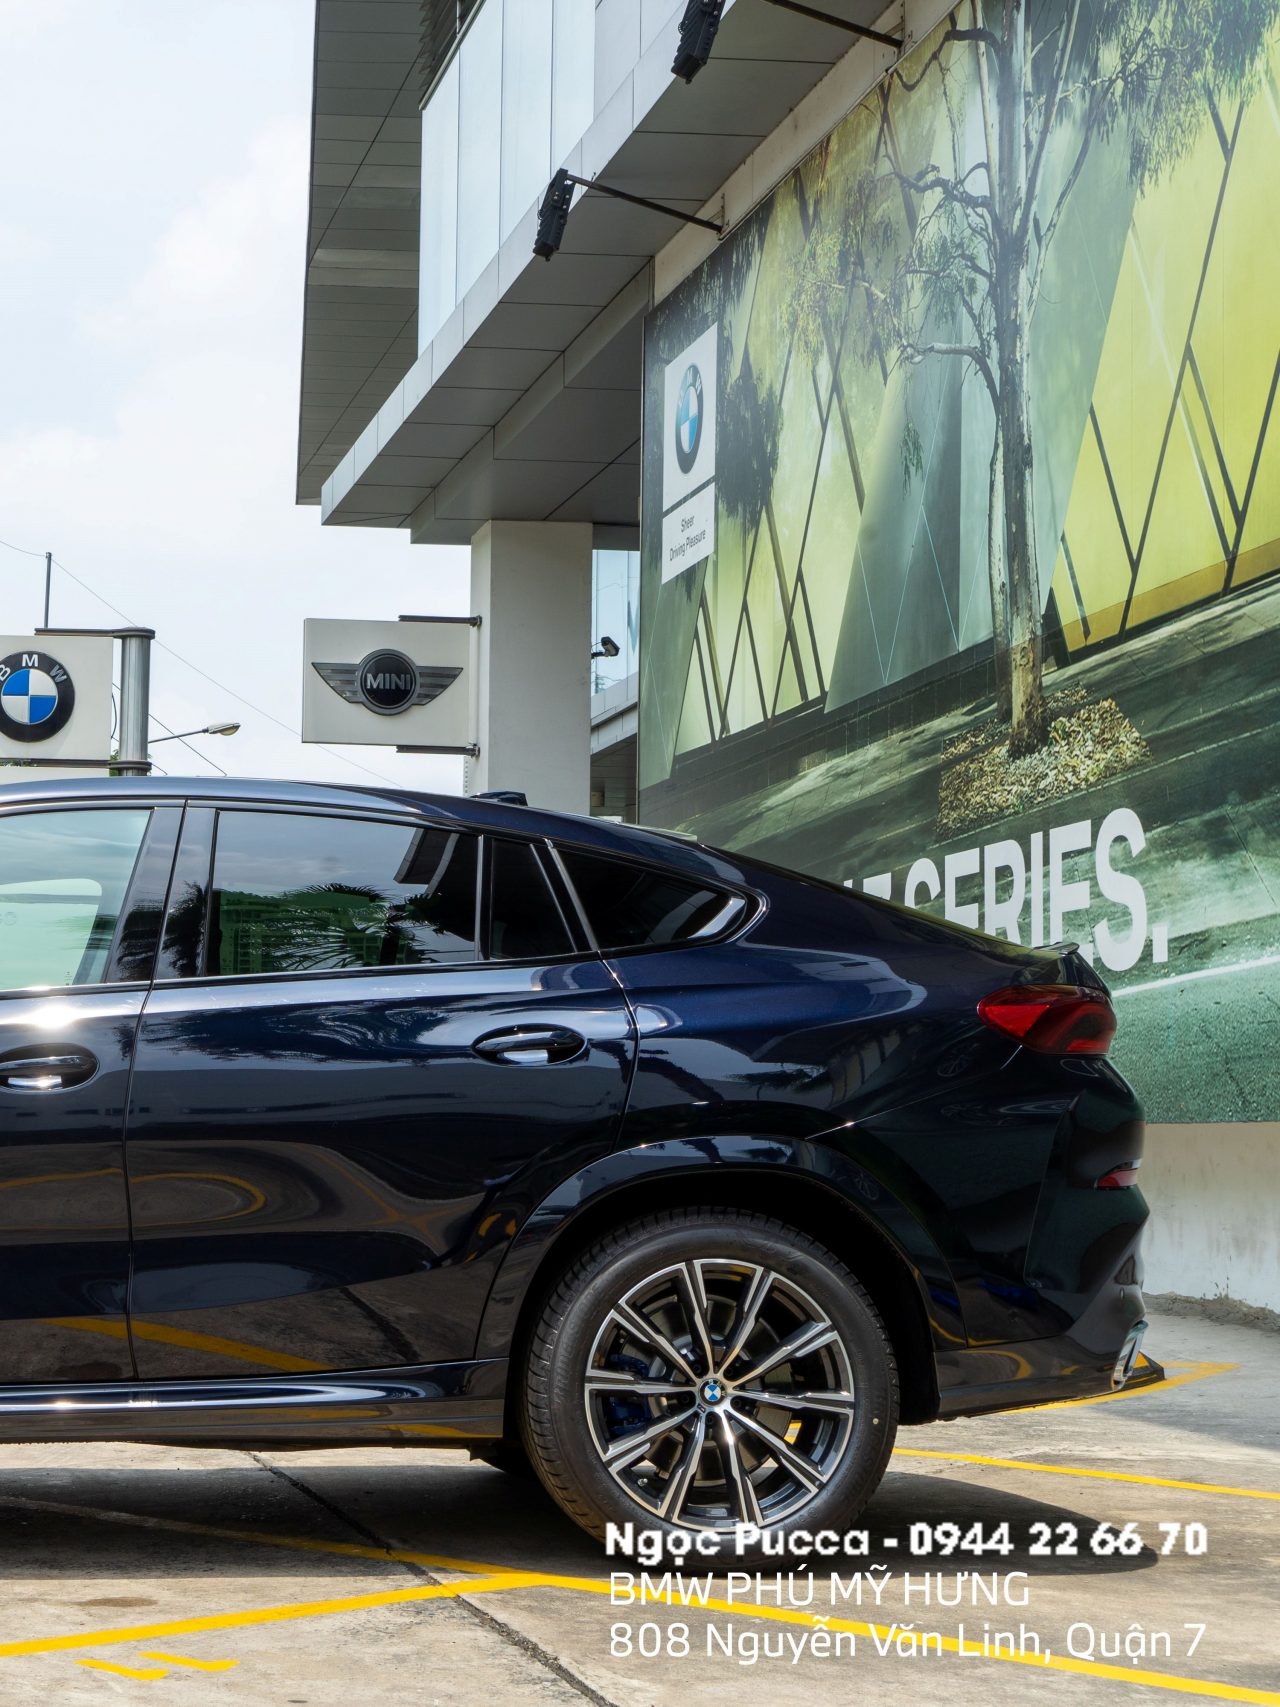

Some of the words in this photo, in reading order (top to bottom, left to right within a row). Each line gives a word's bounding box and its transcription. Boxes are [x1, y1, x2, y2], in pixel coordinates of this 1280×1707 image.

[681, 516, 694, 532] Sheer
[670, 543, 685, 561] Driving
[686, 530, 705, 550] Pleasure
[366, 673, 411, 690] MINI
